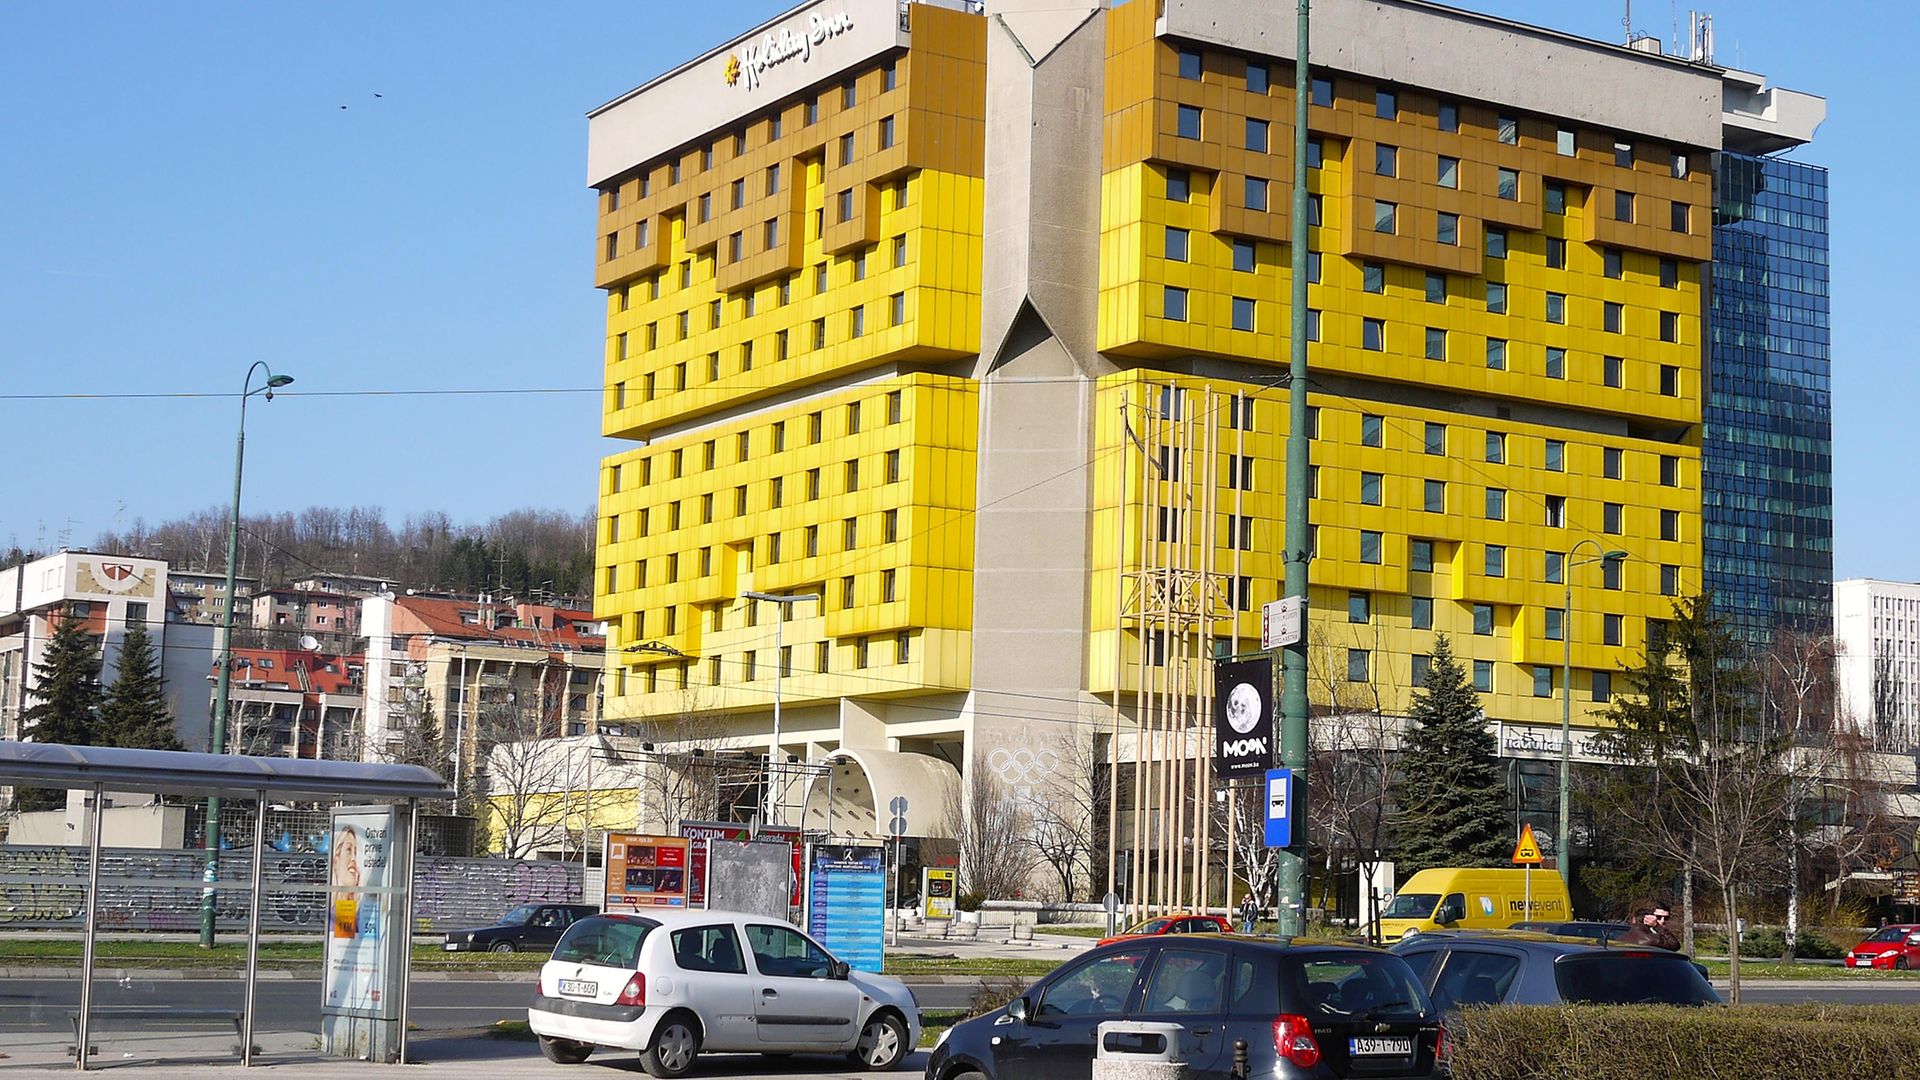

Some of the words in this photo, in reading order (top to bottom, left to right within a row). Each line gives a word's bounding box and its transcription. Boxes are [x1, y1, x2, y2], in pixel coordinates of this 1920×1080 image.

[741, 27, 810, 92] Holiday
[808, 11, 854, 47] Inn
[1223, 736, 1267, 758] MOON
[682, 827, 725, 840] KONZUM
